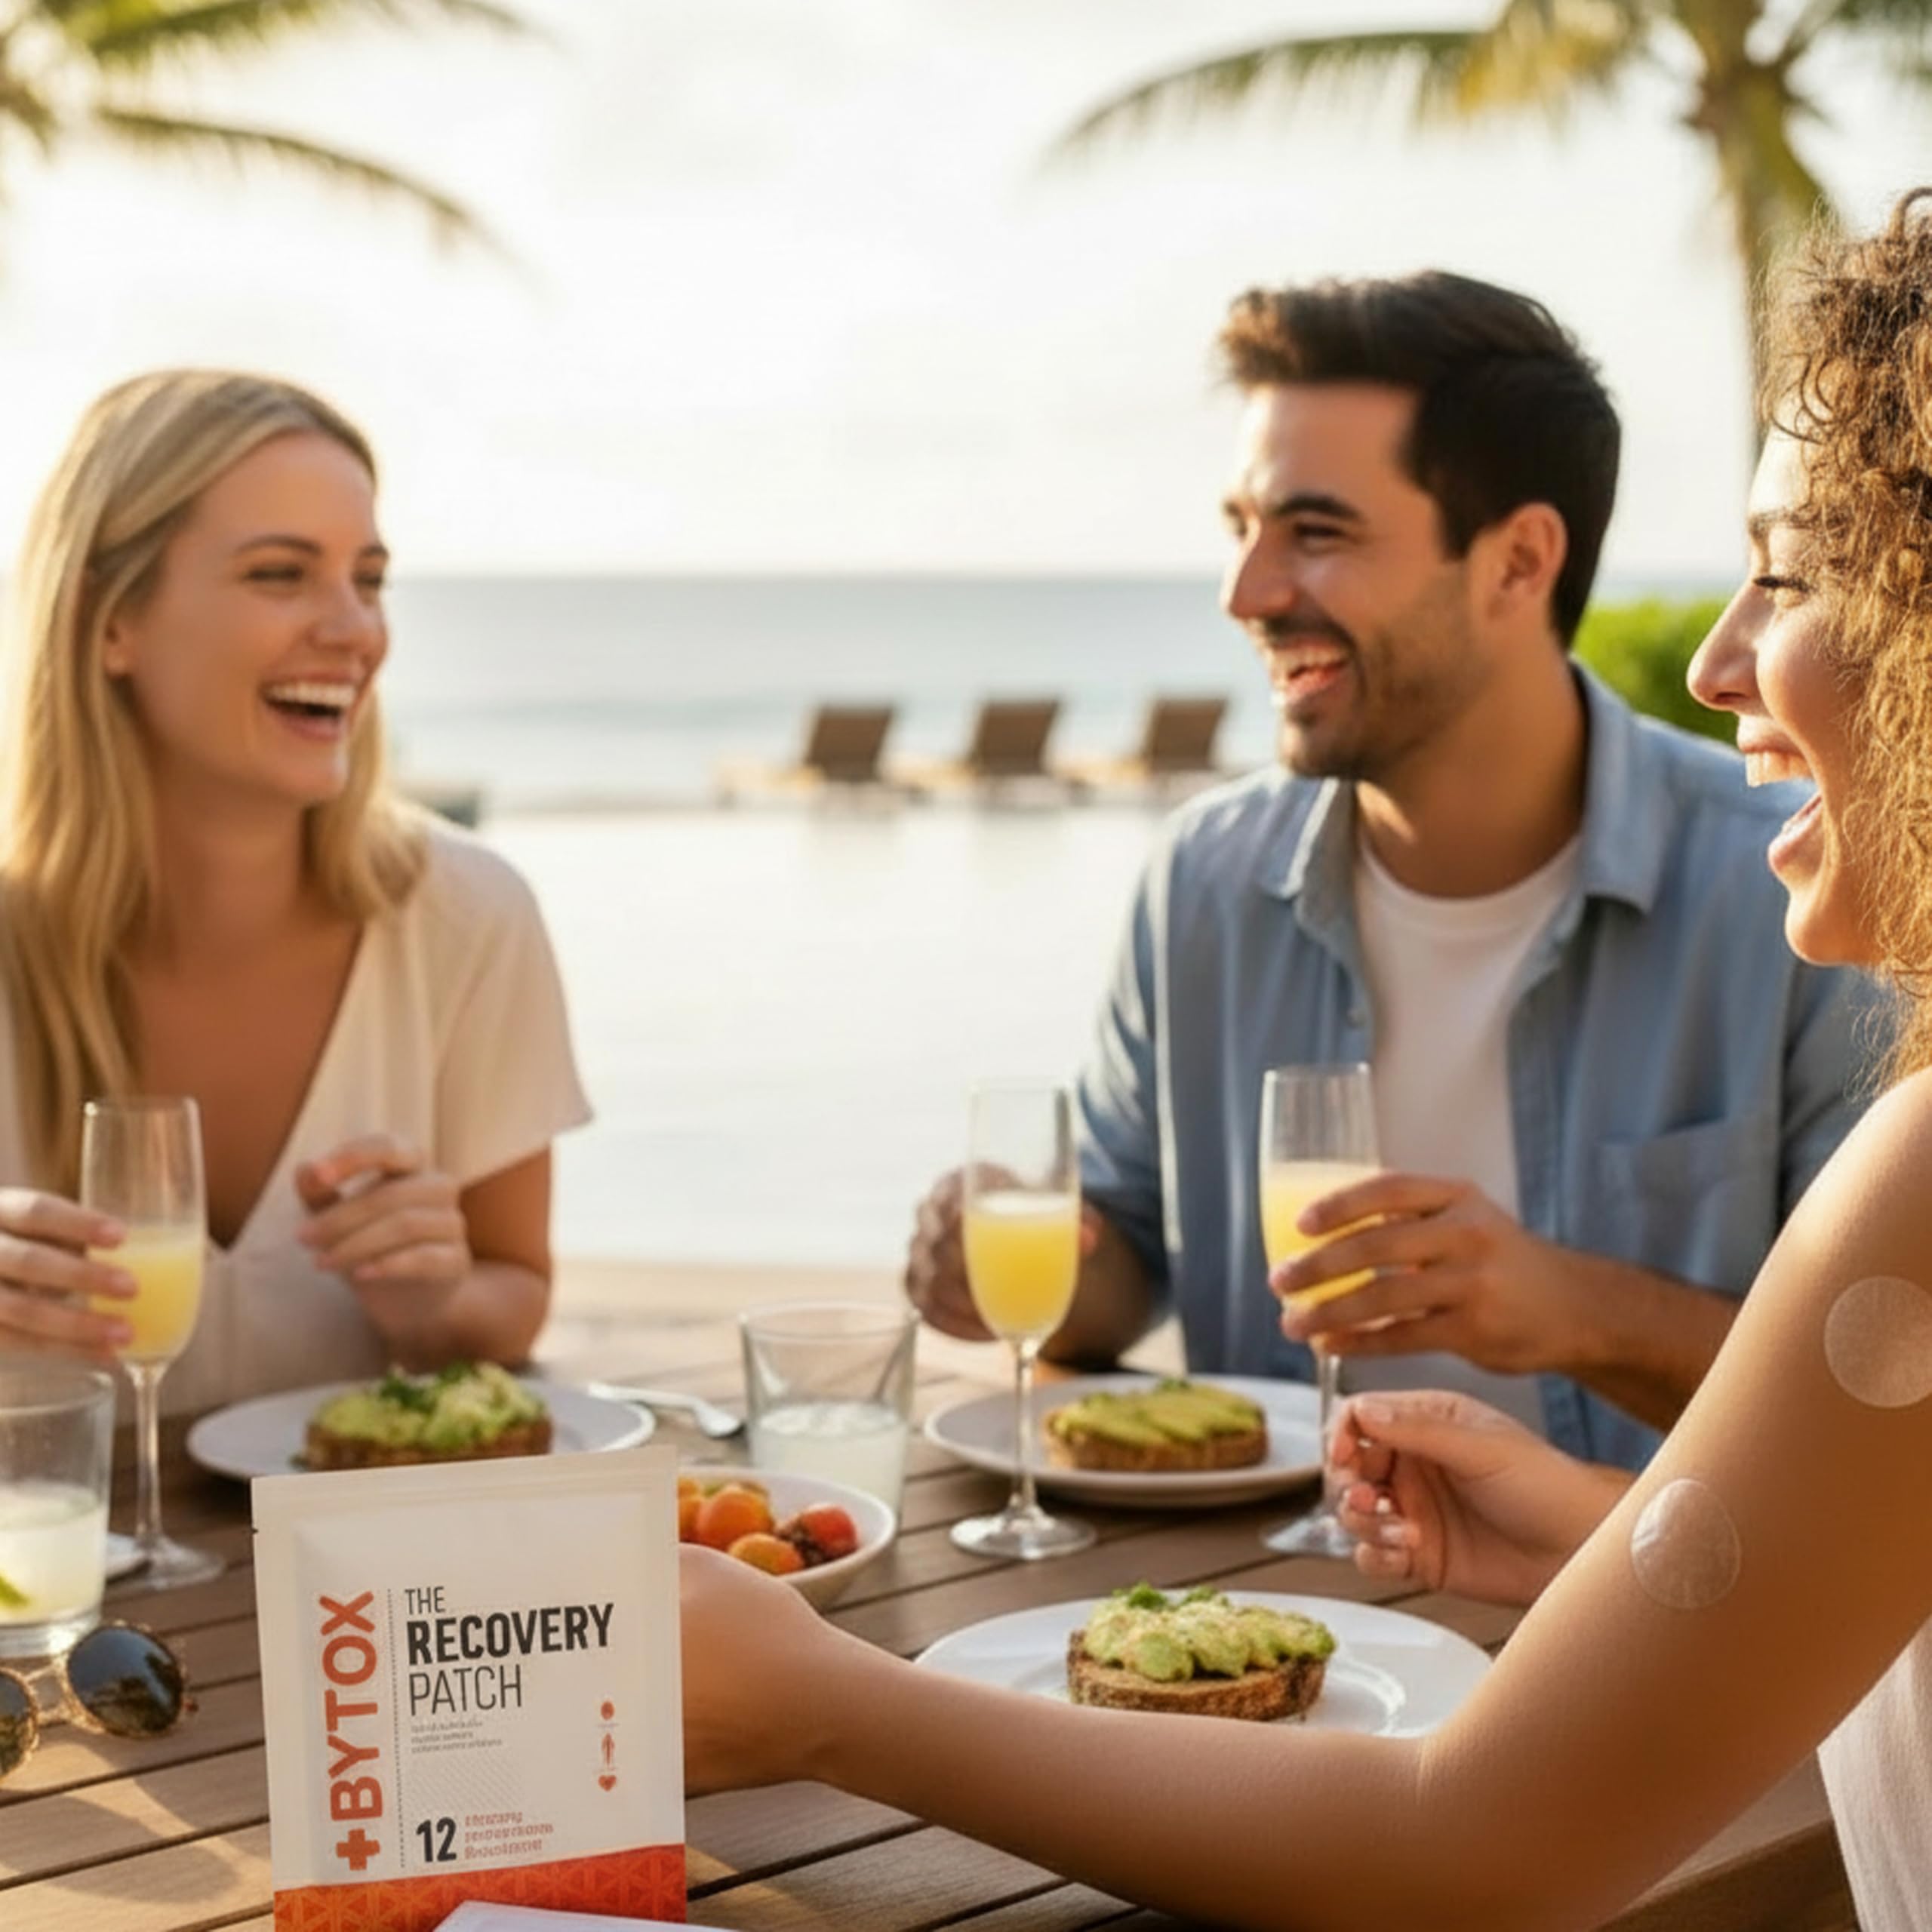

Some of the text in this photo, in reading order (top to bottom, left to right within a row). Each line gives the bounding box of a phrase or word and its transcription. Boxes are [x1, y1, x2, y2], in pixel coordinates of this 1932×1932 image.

[405, 1586, 445, 1615] THE
[407, 1603, 614, 1666] RECOVERY
[409, 1664, 522, 1716] PATCH
[417, 1817, 457, 1863] 12
